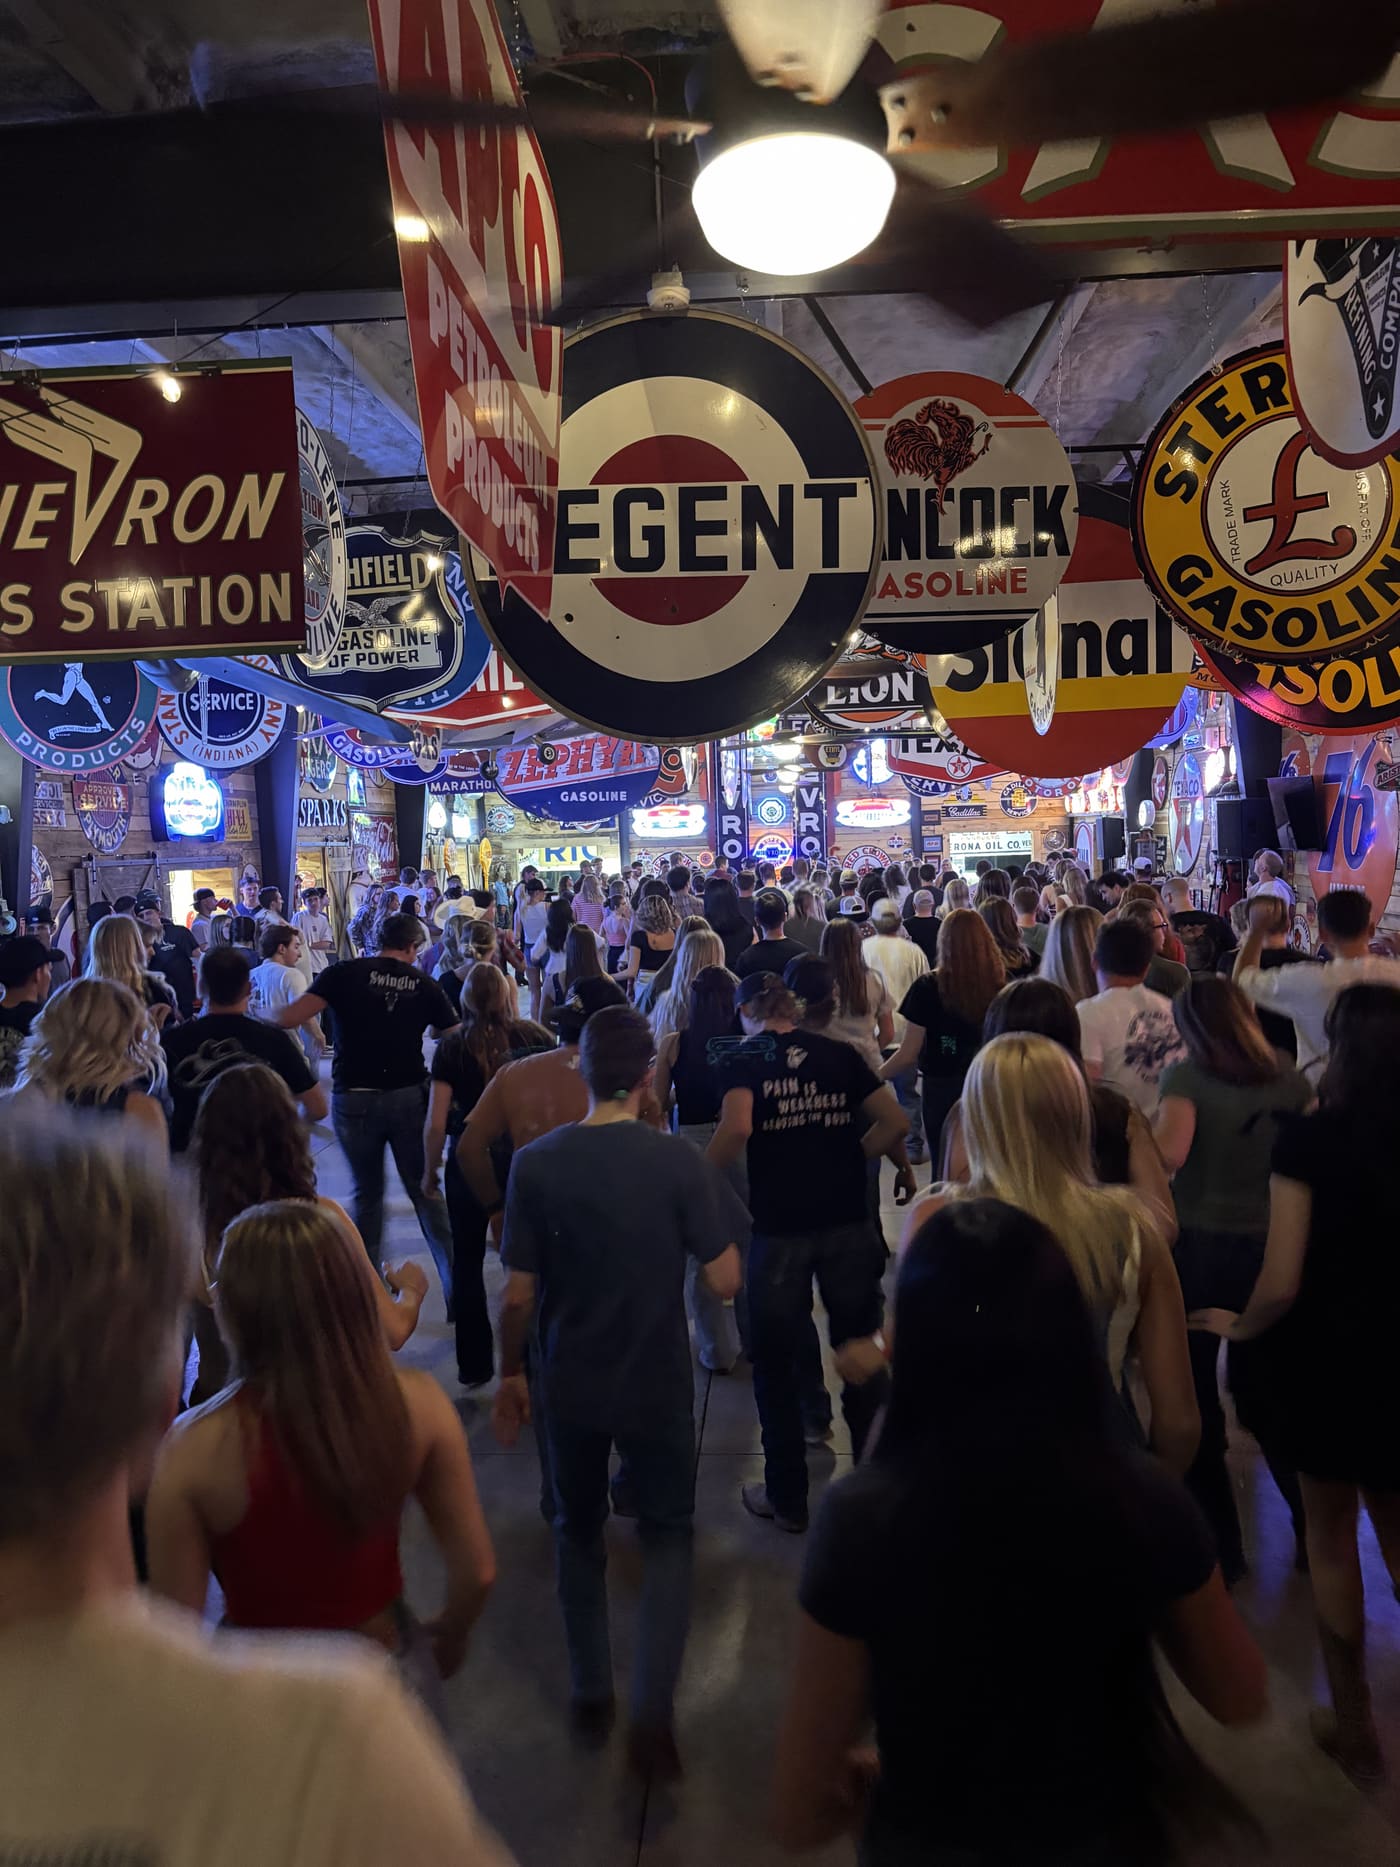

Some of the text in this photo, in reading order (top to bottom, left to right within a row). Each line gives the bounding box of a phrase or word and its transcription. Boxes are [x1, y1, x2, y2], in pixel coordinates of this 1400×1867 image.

[1344, 286, 1377, 385] REFINING
[428, 253, 549, 511] PETROLEUM
[0, 425, 286, 566] EVRON
[297, 422, 342, 540] O-LENE
[444, 388, 539, 575] PRODUCTS
[882, 483, 1071, 562] NCOCK
[1219, 479, 1241, 564] TRADE MARK
[874, 566, 1029, 600] ASOLINE
[1166, 526, 1400, 649] GASOLIN
[1270, 563, 1340, 587] QUALITY
[60, 571, 292, 633] STATION
[356, 650, 420, 667] POWER
[189, 692, 255, 712] SERVICE
[15, 716, 147, 769] PRODUCTS
[192, 740, 259, 762] (INDIANA)
[560, 791, 628, 802] GASOLINE
[1173, 778, 1200, 797] TEXACO
[299, 799, 347, 827] SPARKS
[948, 806, 982, 817] Cadillac
[1316, 737, 1376, 873] 76
[83, 812, 128, 850] PLYMOUTH
[953, 841, 982, 851] RONA
[985, 841, 1003, 850] OIL
[1007, 840, 1021, 850] CO.
[844, 847, 890, 869] RED CROWN
[763, 1077, 817, 1099] PAIN IS
[778, 1093, 847, 1114] WEAKNESS
